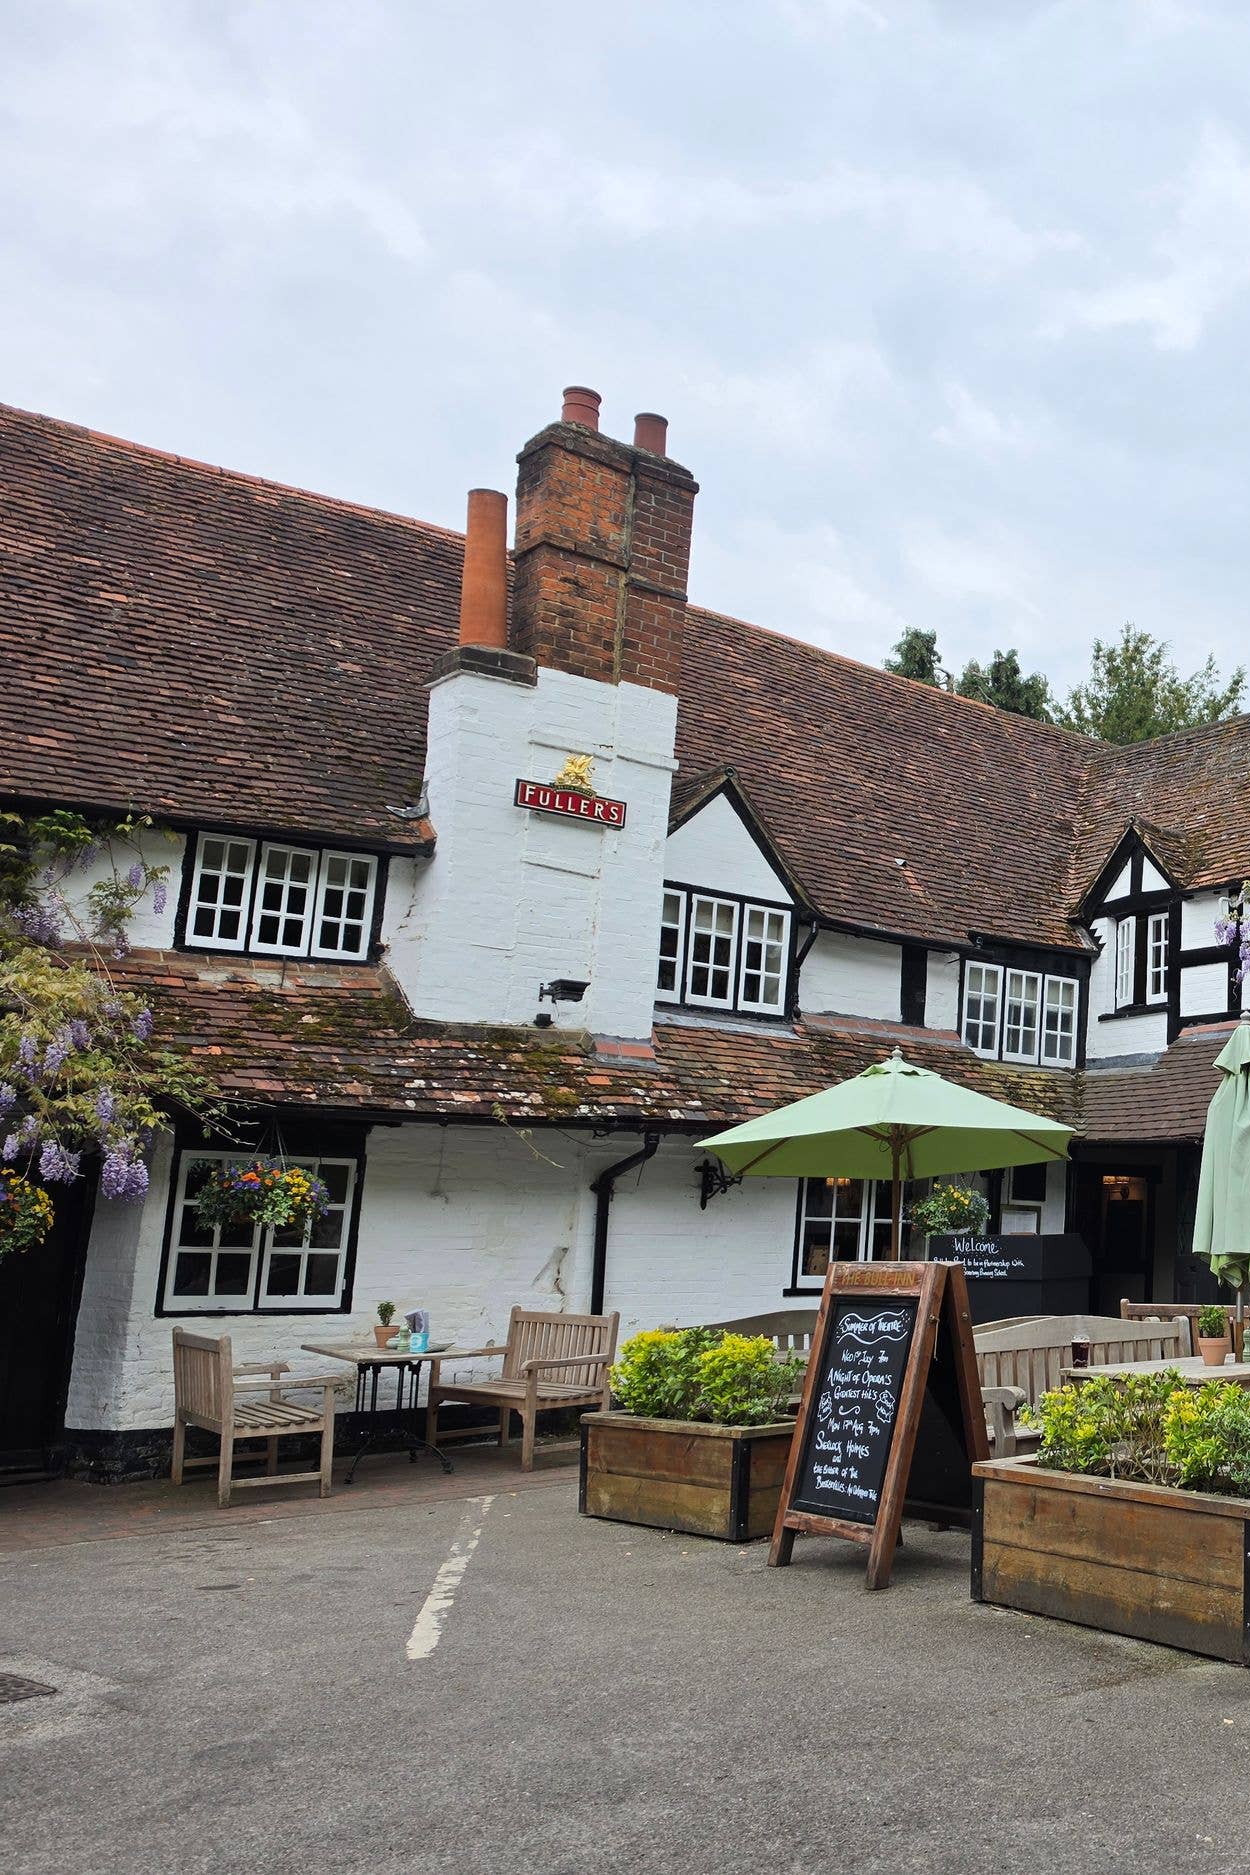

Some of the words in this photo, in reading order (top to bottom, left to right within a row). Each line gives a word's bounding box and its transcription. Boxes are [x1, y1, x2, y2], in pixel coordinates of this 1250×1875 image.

[525, 785, 619, 821] FULLER'S
[954, 1237, 1000, 1254] Welcome
[842, 1271, 861, 1286] THE
[864, 1271, 889, 1287] BULL
[893, 1271, 917, 1287] INN
